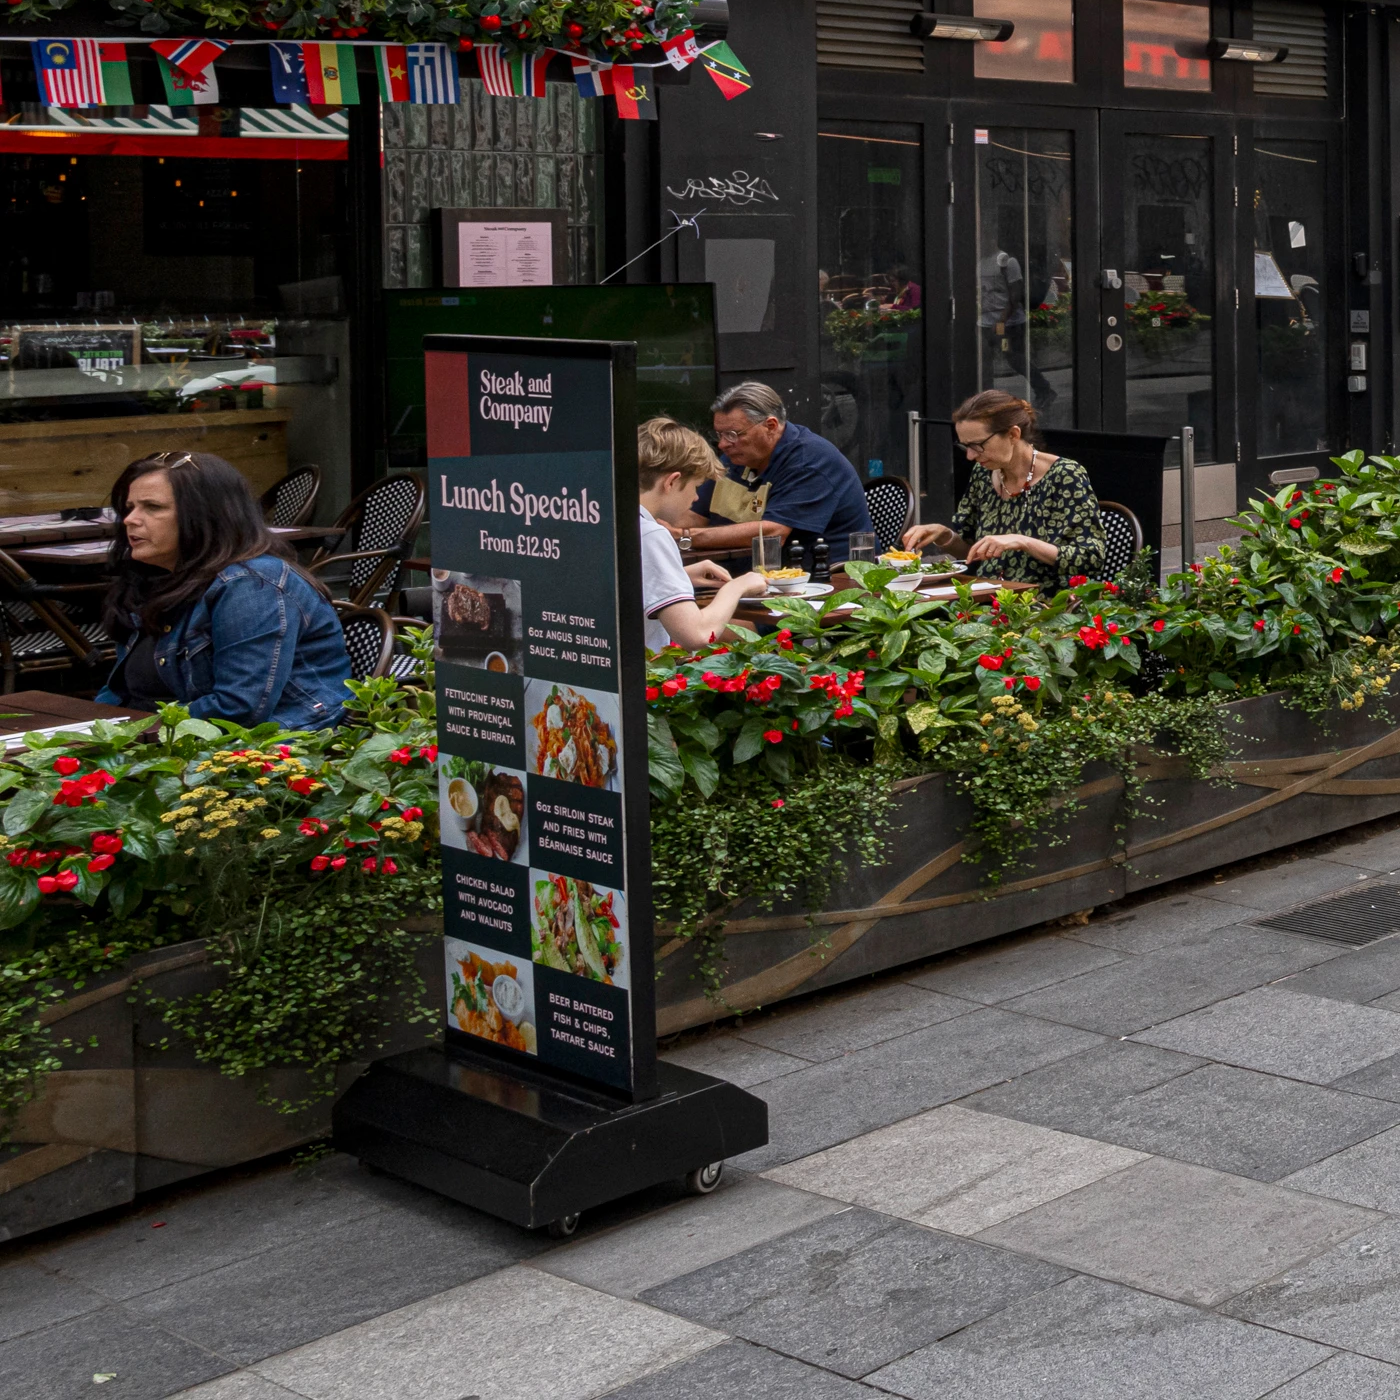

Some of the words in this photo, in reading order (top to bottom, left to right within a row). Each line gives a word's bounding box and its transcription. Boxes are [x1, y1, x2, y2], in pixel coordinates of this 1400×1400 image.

[480, 369, 525, 396] Steak
[528, 373, 552, 394] and
[480, 395, 553, 432] Company
[440, 475, 506, 513] Lunch
[510, 481, 600, 526] Specials
[480, 530, 514, 554] From
[517, 534, 561, 560] £12.95
[542, 611, 567, 623] STEAK
[569, 616, 596, 629] STONE
[528, 627, 544, 638] 6oz
[546, 631, 573, 643] ANGUS
[575, 635, 611, 651] SIRLOIN,
[529, 645, 559, 660] SAUCE,
[561, 650, 578, 662] AND
[581, 654, 611, 668] BUTTER
[445, 687, 488, 705] FETTUCCINE
[491, 696, 515, 710] PASTA
[448, 706, 466, 717] WITH
[468, 709, 512, 728] PROVENÇAL
[446, 723, 471, 736] SAUCE
[473, 728, 479, 738] &
[481, 731, 516, 746] BURRATA
[536, 801, 551, 813] 6oz
[554, 806, 585, 821] SIRLOIN
[588, 813, 614, 828] STEAK
[543, 821, 560, 833] AND
[562, 825, 585, 839] FRIES
[588, 831, 607, 845] WITH
[539, 835, 583, 857] BÉARNAISE
[586, 849, 613, 864] SAUCE
[455, 873, 488, 890] CHICKEN
[490, 883, 515, 898] SALAD
[458, 891, 476, 904] WITH
[478, 897, 513, 915] AVOCADO
[460, 909, 476, 921] AND
[478, 914, 513, 932] WALNUTS
[549, 992, 570, 1008] BEER
[573, 1000, 614, 1021] BATTERED
[553, 1012, 571, 1026] FISH
[574, 1018, 580, 1028] &
[583, 1021, 611, 1039] CHIPS,
[551, 1028, 585, 1048] TARTARE
[588, 1040, 615, 1057] SAUCE
